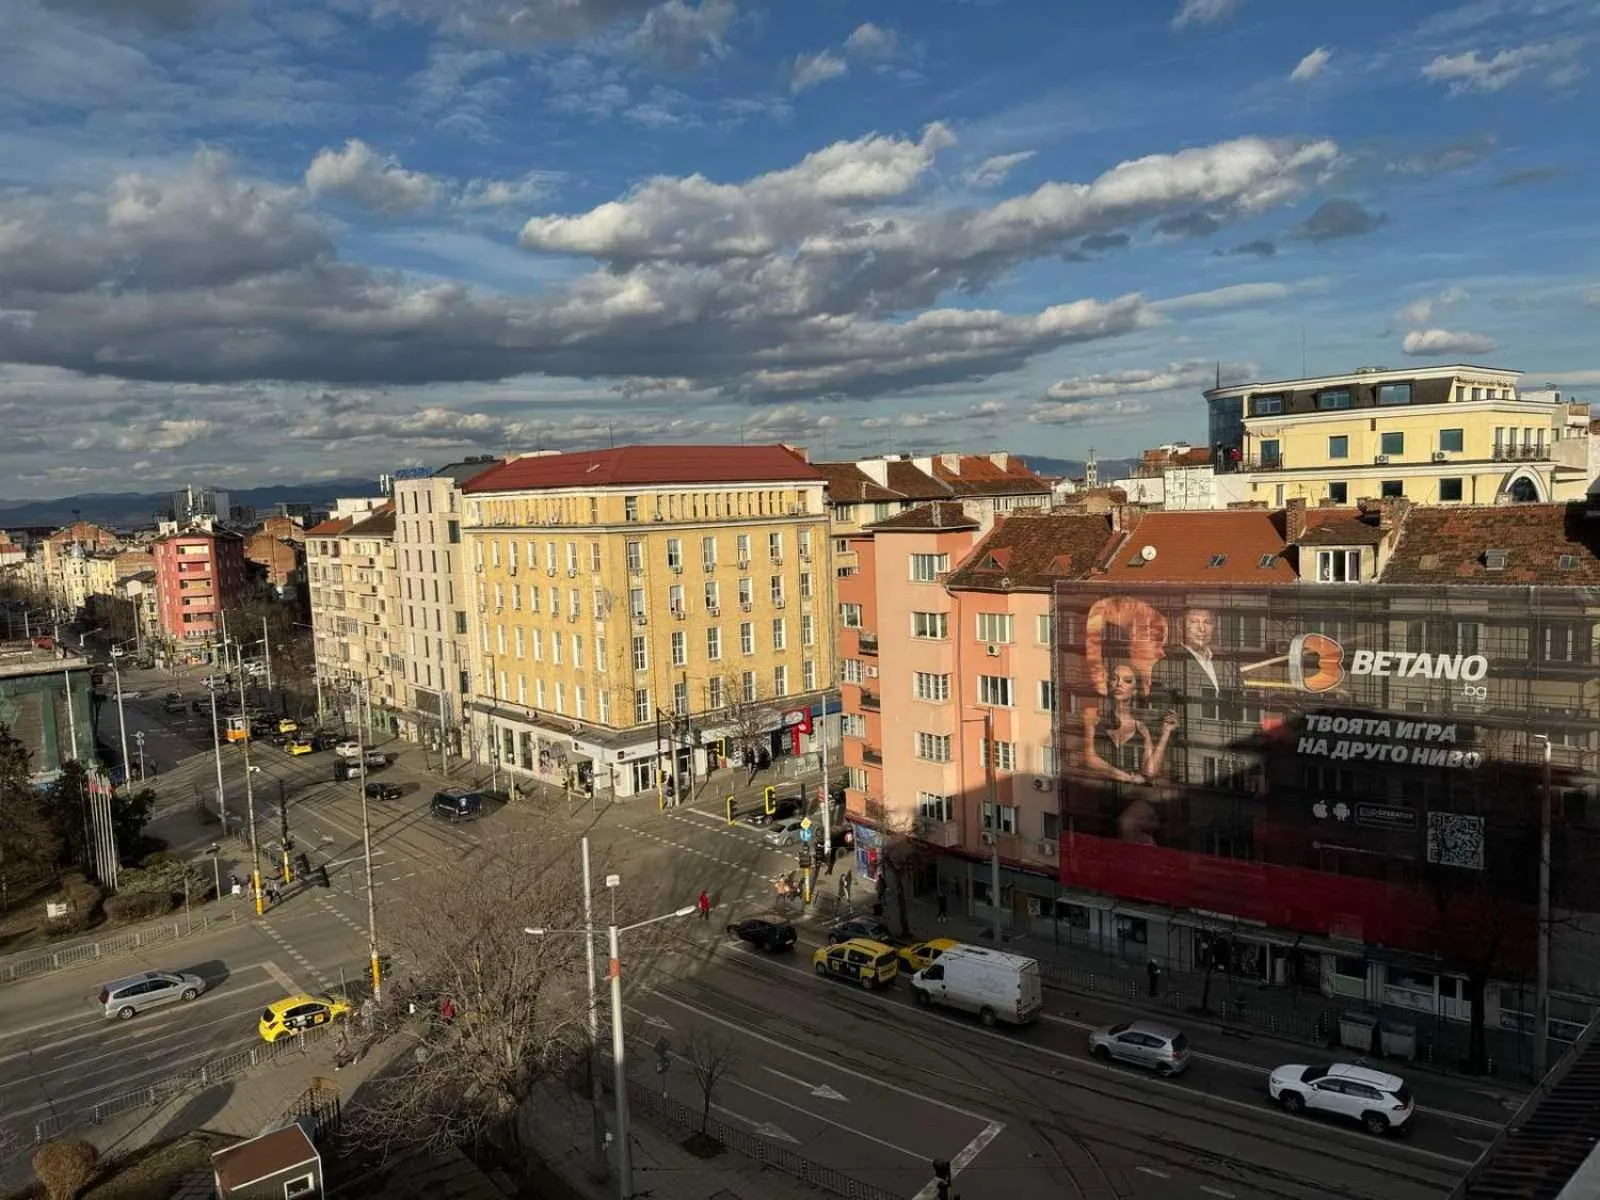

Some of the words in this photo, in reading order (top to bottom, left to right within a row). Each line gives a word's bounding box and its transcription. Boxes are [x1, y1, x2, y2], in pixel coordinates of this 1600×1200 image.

[1351, 650, 1488, 681] BETANO
[1461, 683, 1487, 700] .bg
[1305, 714, 1391, 737] ТВОЯТА
[1395, 721, 1457, 743] ИГРА
[1297, 737, 1328, 756] НА
[1330, 740, 1408, 763] ДРУГО
[1411, 748, 1482, 769] НИВО
